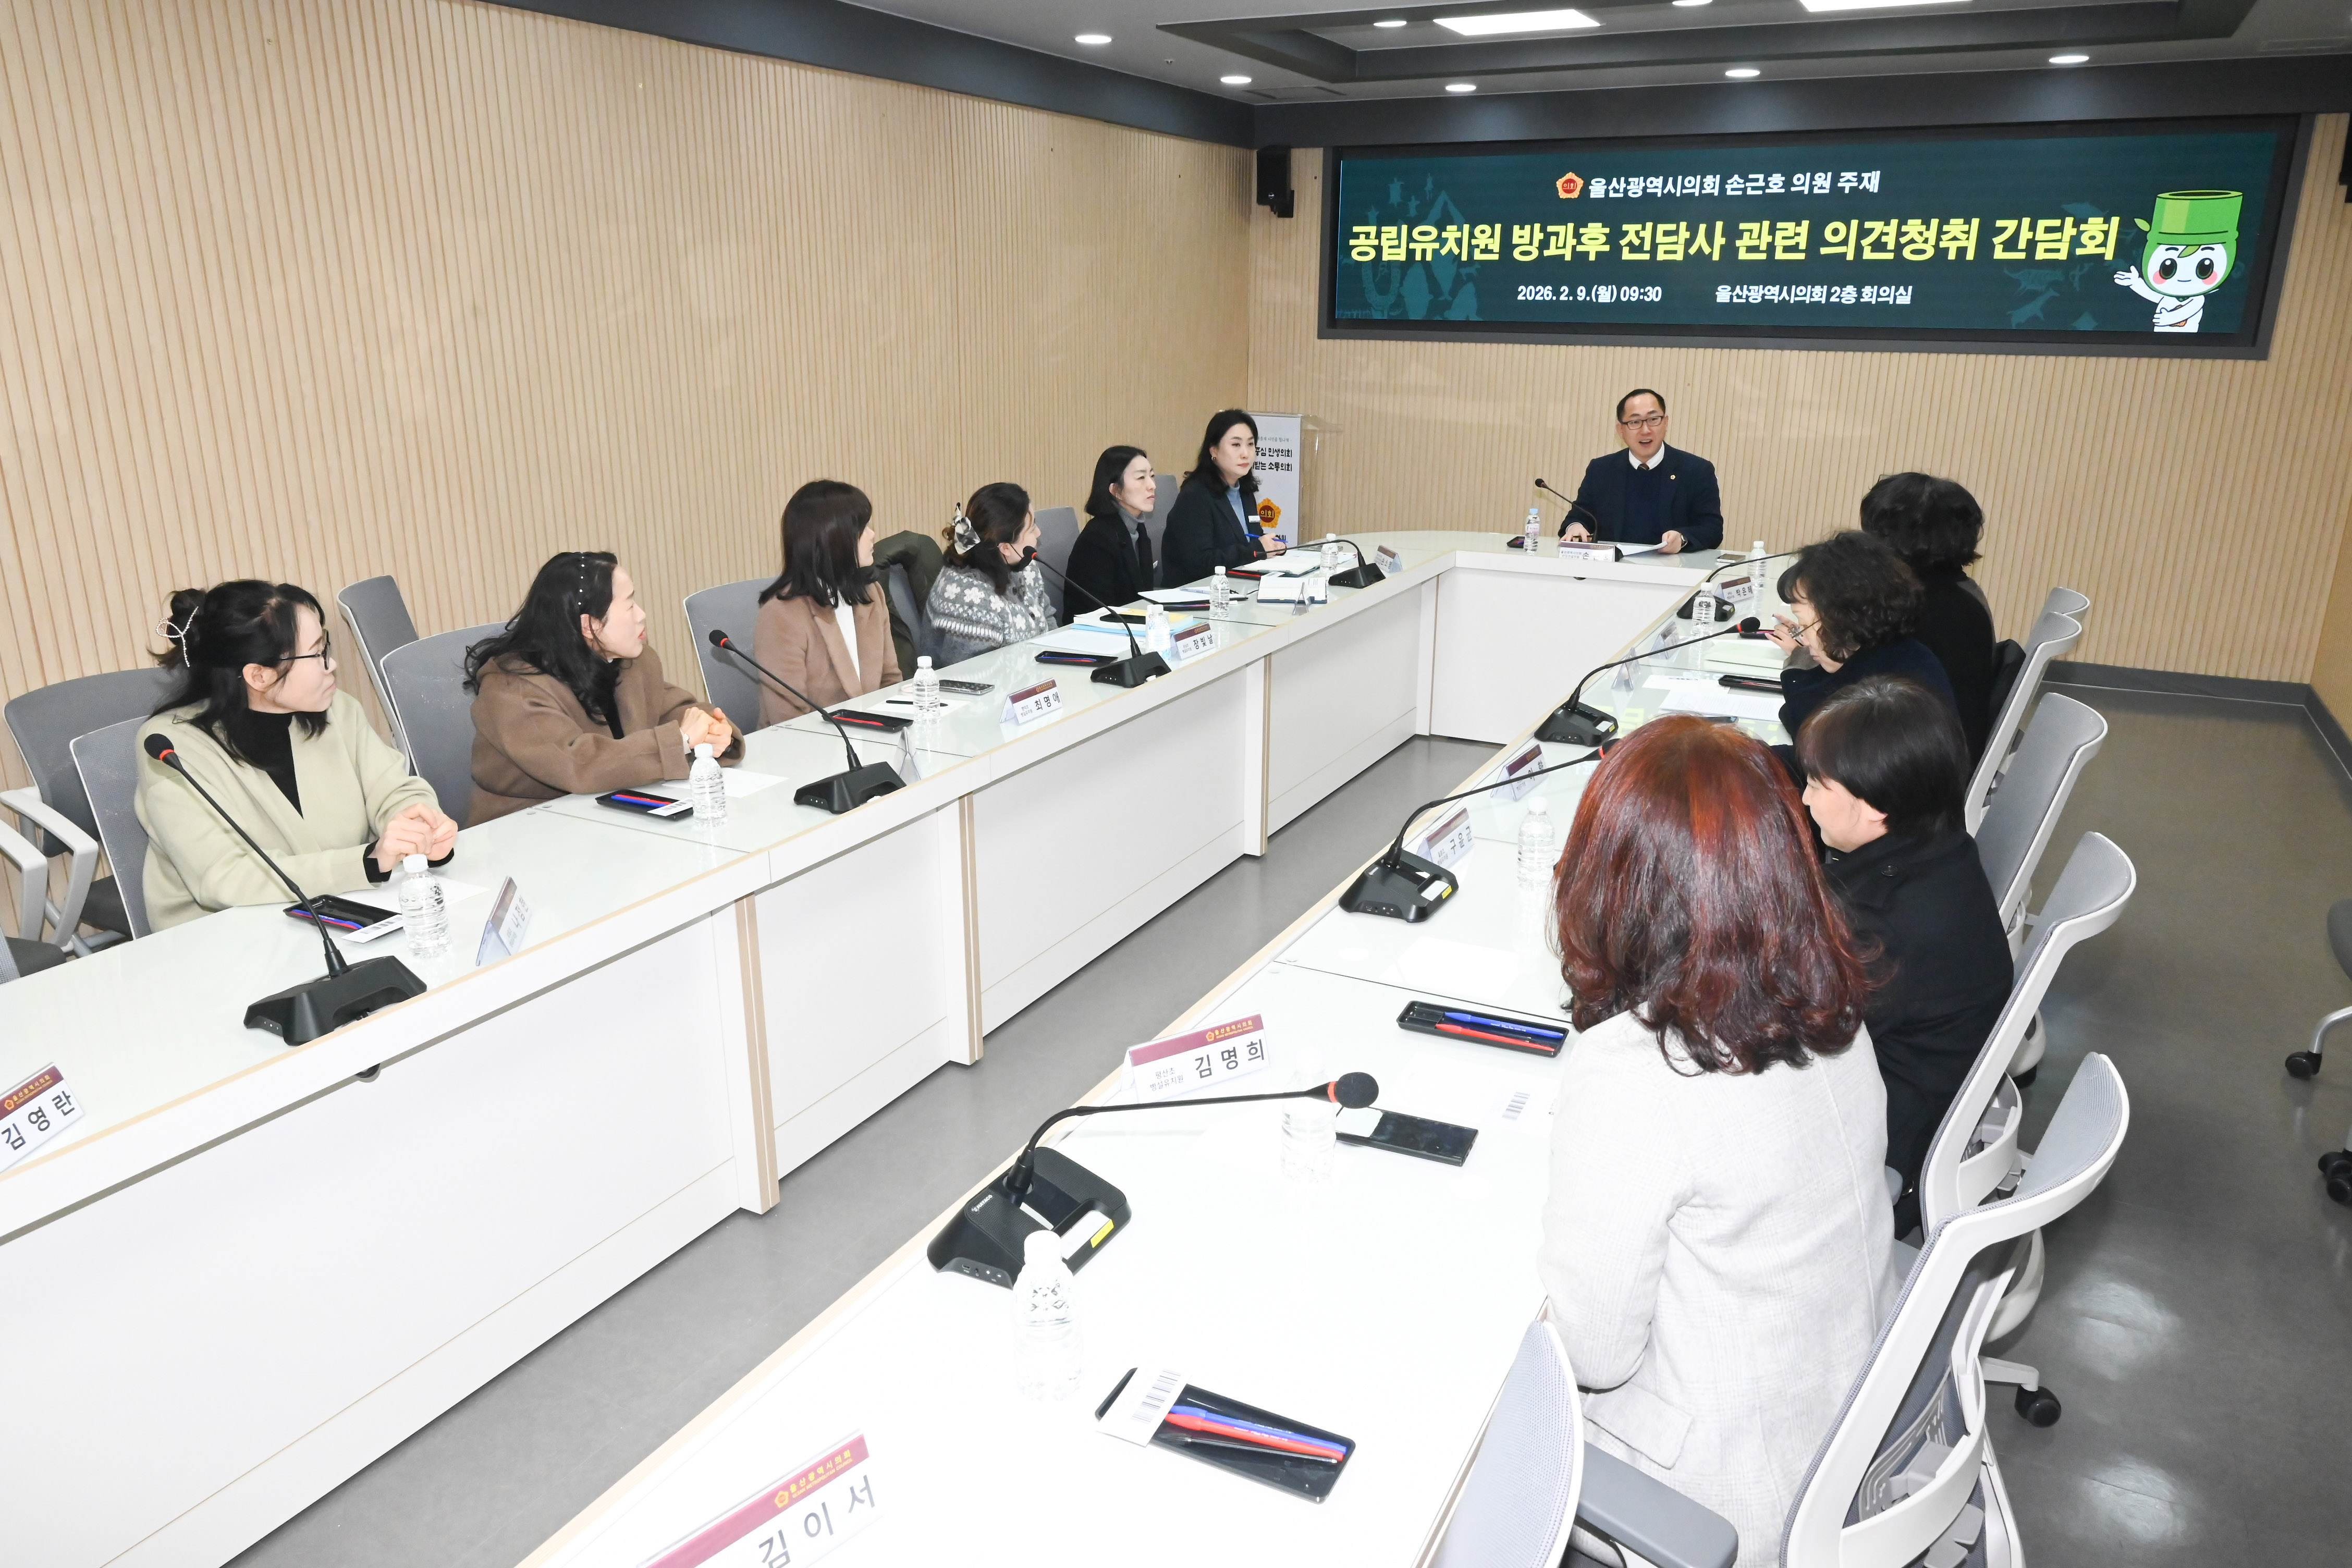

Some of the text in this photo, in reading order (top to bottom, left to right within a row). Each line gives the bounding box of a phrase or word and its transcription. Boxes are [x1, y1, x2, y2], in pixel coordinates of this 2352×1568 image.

[1589, 170, 1881, 198] 울산광역시의회 손근호 의원 주재
[1349, 216, 2120, 262] 공립유치원 방과후 전담사 관련 의견청취 간담회
[1517, 286, 1557, 301] 2026.
[1559, 286, 1573, 301] 2.
[1620, 286, 1662, 302] 09:30
[1715, 285, 1913, 304] 울산광역시의회 2층 회의실
[1268, 447, 1292, 458] 민생의회
[1253, 460, 1292, 472] 받는 소통의회
[1260, 509, 1274, 518] 의회
[1193, 634, 1214, 650] 장빛날
[1035, 691, 1060, 710] 최명애
[1215, 1020, 1252, 1035] 울산광역시의회
[1195, 1039, 1265, 1079] 김명희
[13, 1074, 51, 1101] 울산광역시의회
[1150, 1074, 1184, 1092] 병설유치원
[1, 1091, 75, 1151] 김영란
[790, 1449, 851, 1493] 울산광역시의회
[758, 1474, 875, 1568] 김이서
